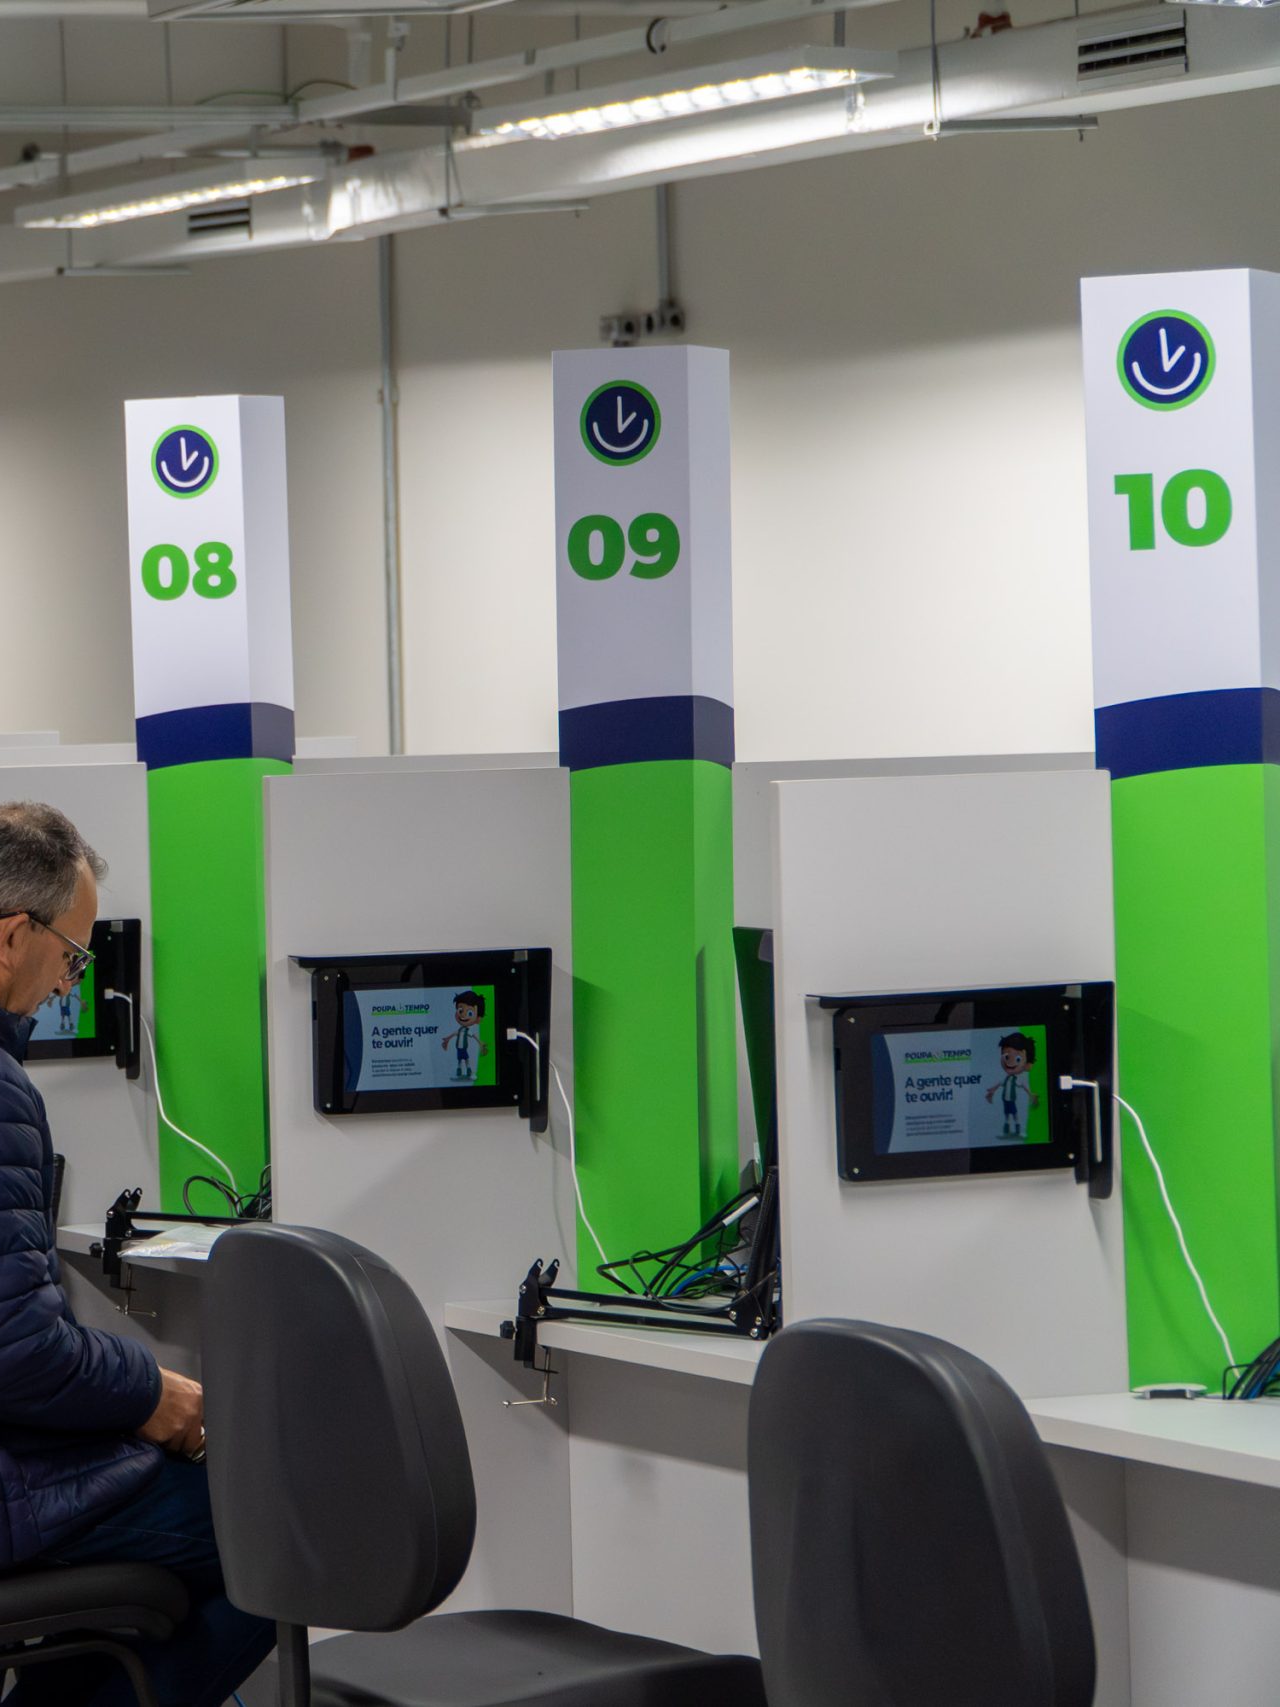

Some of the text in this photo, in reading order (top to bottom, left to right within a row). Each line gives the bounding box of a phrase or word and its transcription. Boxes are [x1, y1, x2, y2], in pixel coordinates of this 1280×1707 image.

[1114, 469, 1232, 551] 10
[567, 512, 680, 581] 09
[141, 541, 237, 601] 08
[371, 1026, 438, 1039] A gente quer
[372, 1036, 414, 1049] te ouvir!
[905, 1049, 972, 1060] POUPA TEMPO
[905, 1075, 982, 1091] A gente quer
[905, 1088, 953, 1103] te ouvir!
